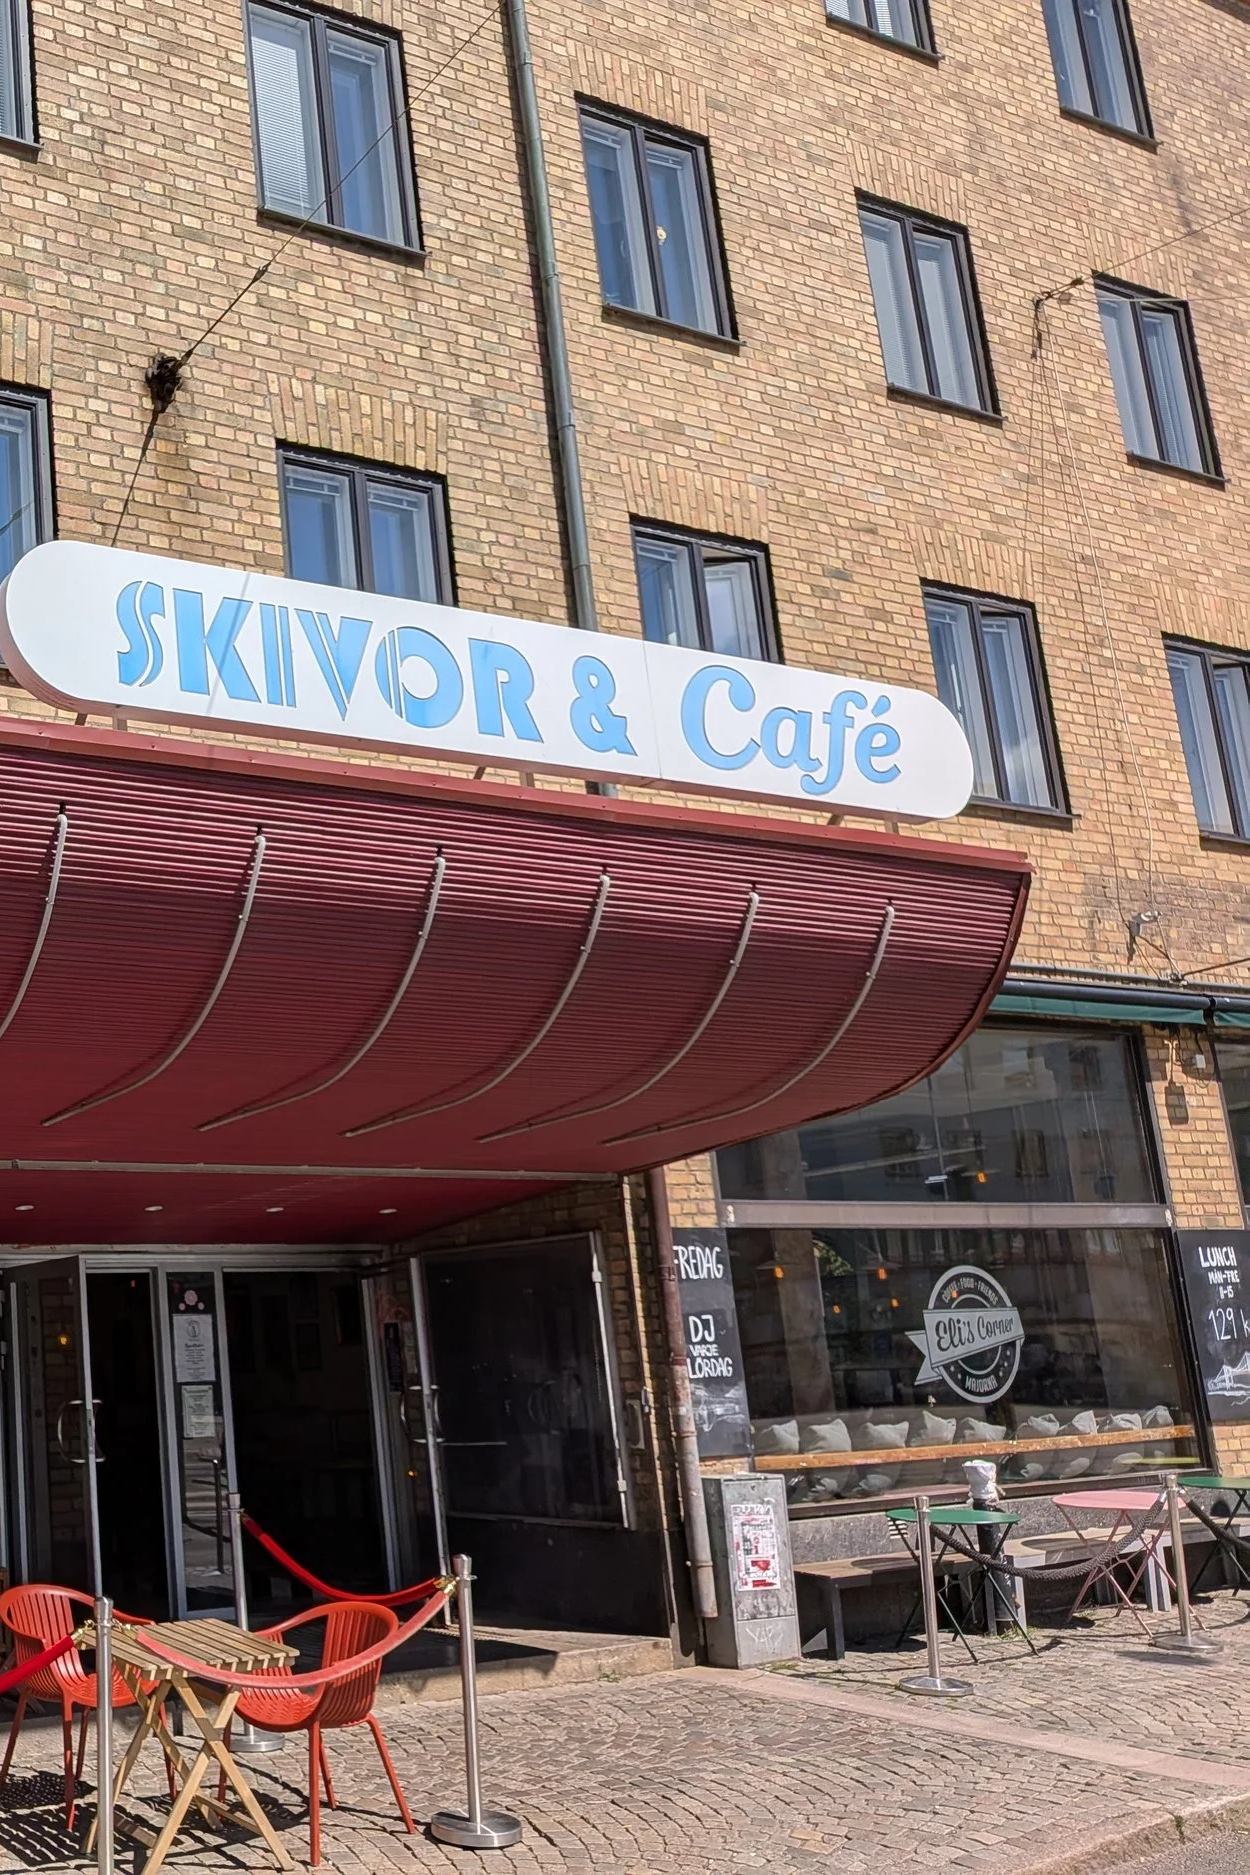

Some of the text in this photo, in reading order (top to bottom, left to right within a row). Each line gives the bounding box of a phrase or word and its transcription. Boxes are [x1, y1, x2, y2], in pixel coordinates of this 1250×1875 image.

[117, 581, 902, 795] SKIVOR & Café
[1198, 1246, 1237, 1268] LUNCH
[978, 1281, 998, 1305] FRIENDS
[689, 1314, 715, 1342] DJ
[935, 1316, 1014, 1352] Eli's Corner
[1208, 1307, 1237, 1341] 129
[689, 1344, 719, 1356] VARJE
[687, 1357, 733, 1378] LÖRDAG
